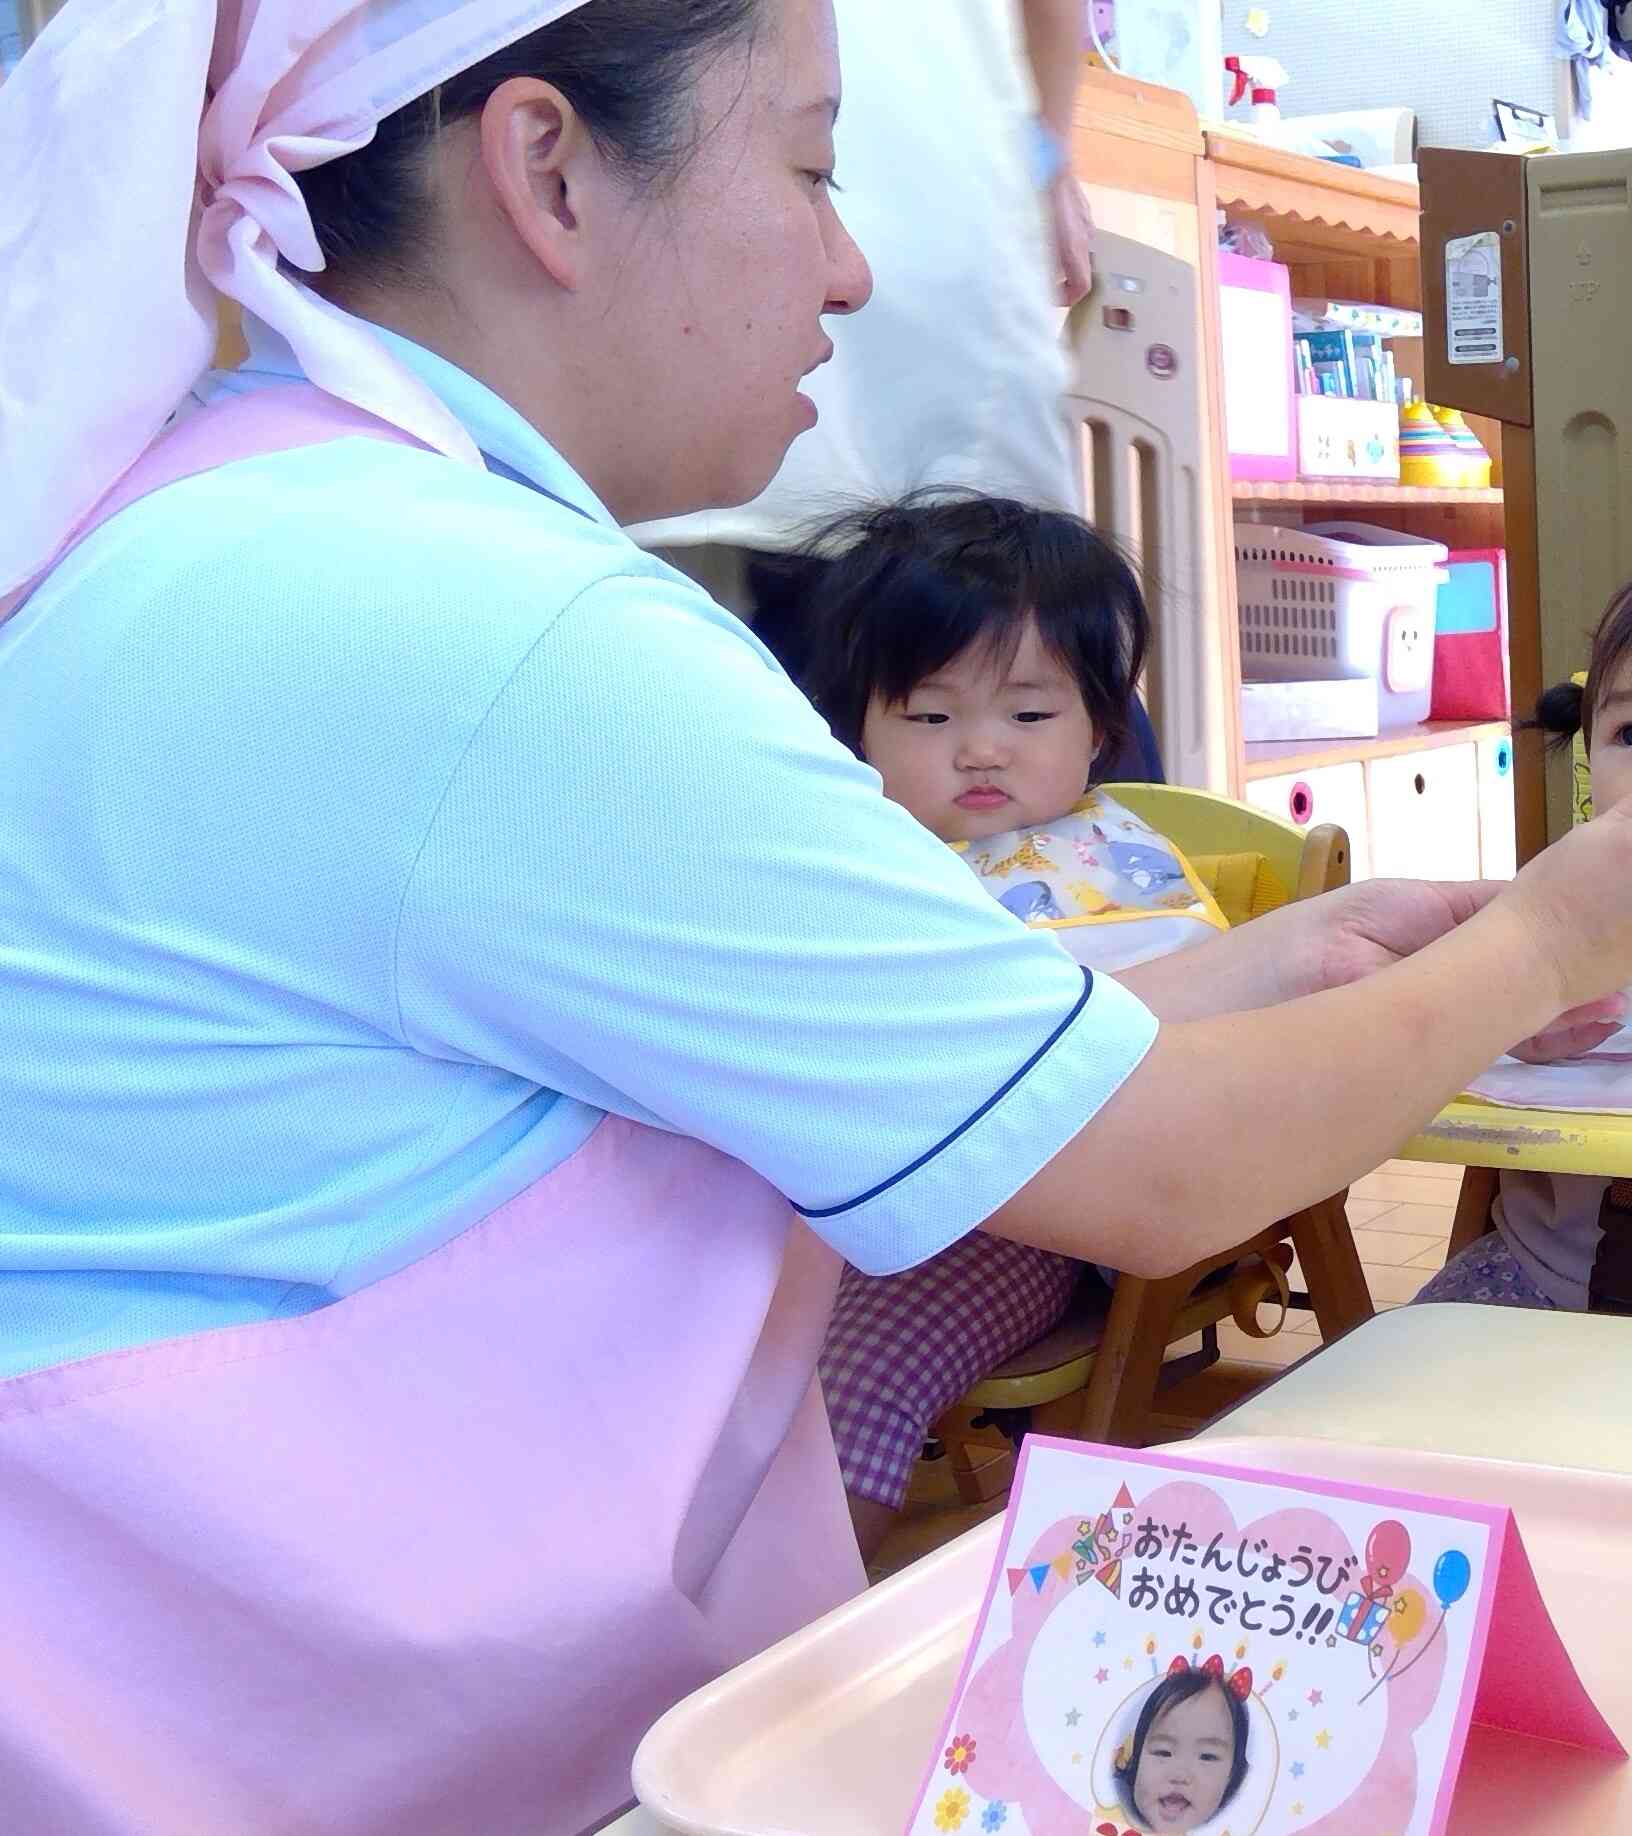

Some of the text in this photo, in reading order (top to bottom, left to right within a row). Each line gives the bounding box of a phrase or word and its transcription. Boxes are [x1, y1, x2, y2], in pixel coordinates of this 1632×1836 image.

[1134, 1516, 1359, 1595] おたんじょうび
[1128, 1566, 1334, 1645] おめでとう!!
